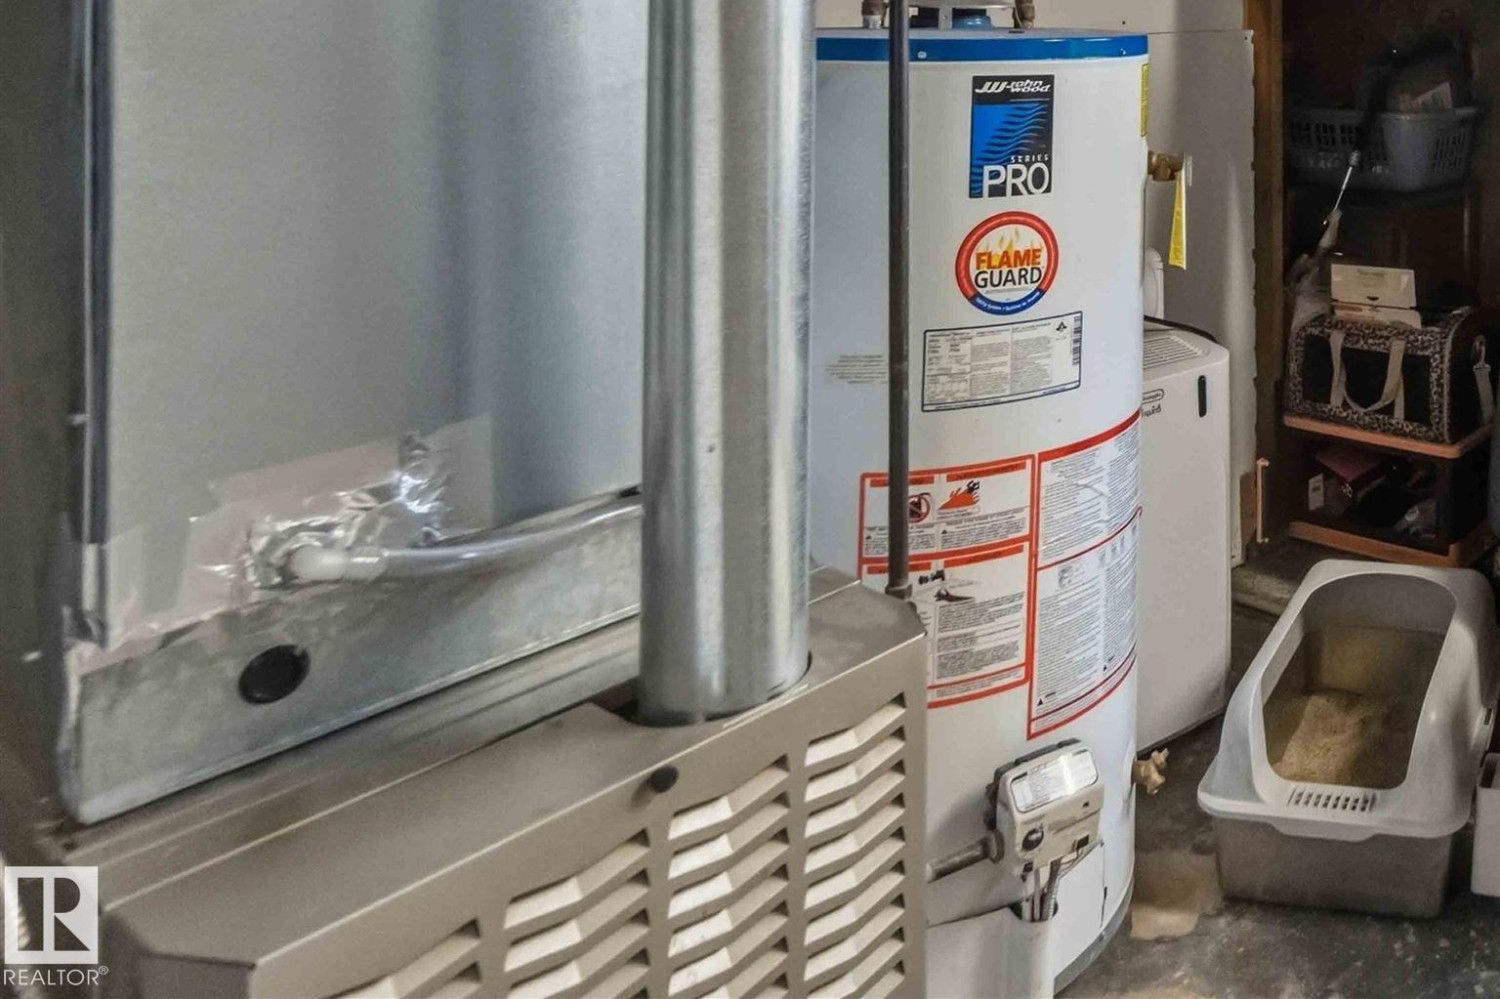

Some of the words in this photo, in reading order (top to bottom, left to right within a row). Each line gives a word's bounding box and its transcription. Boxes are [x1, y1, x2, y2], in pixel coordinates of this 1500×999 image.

[1010, 153, 1049, 163] SERIES
[982, 162, 1050, 198] PRO
[975, 248, 1042, 271] FLAME
[974, 266, 1042, 289] GUARD
